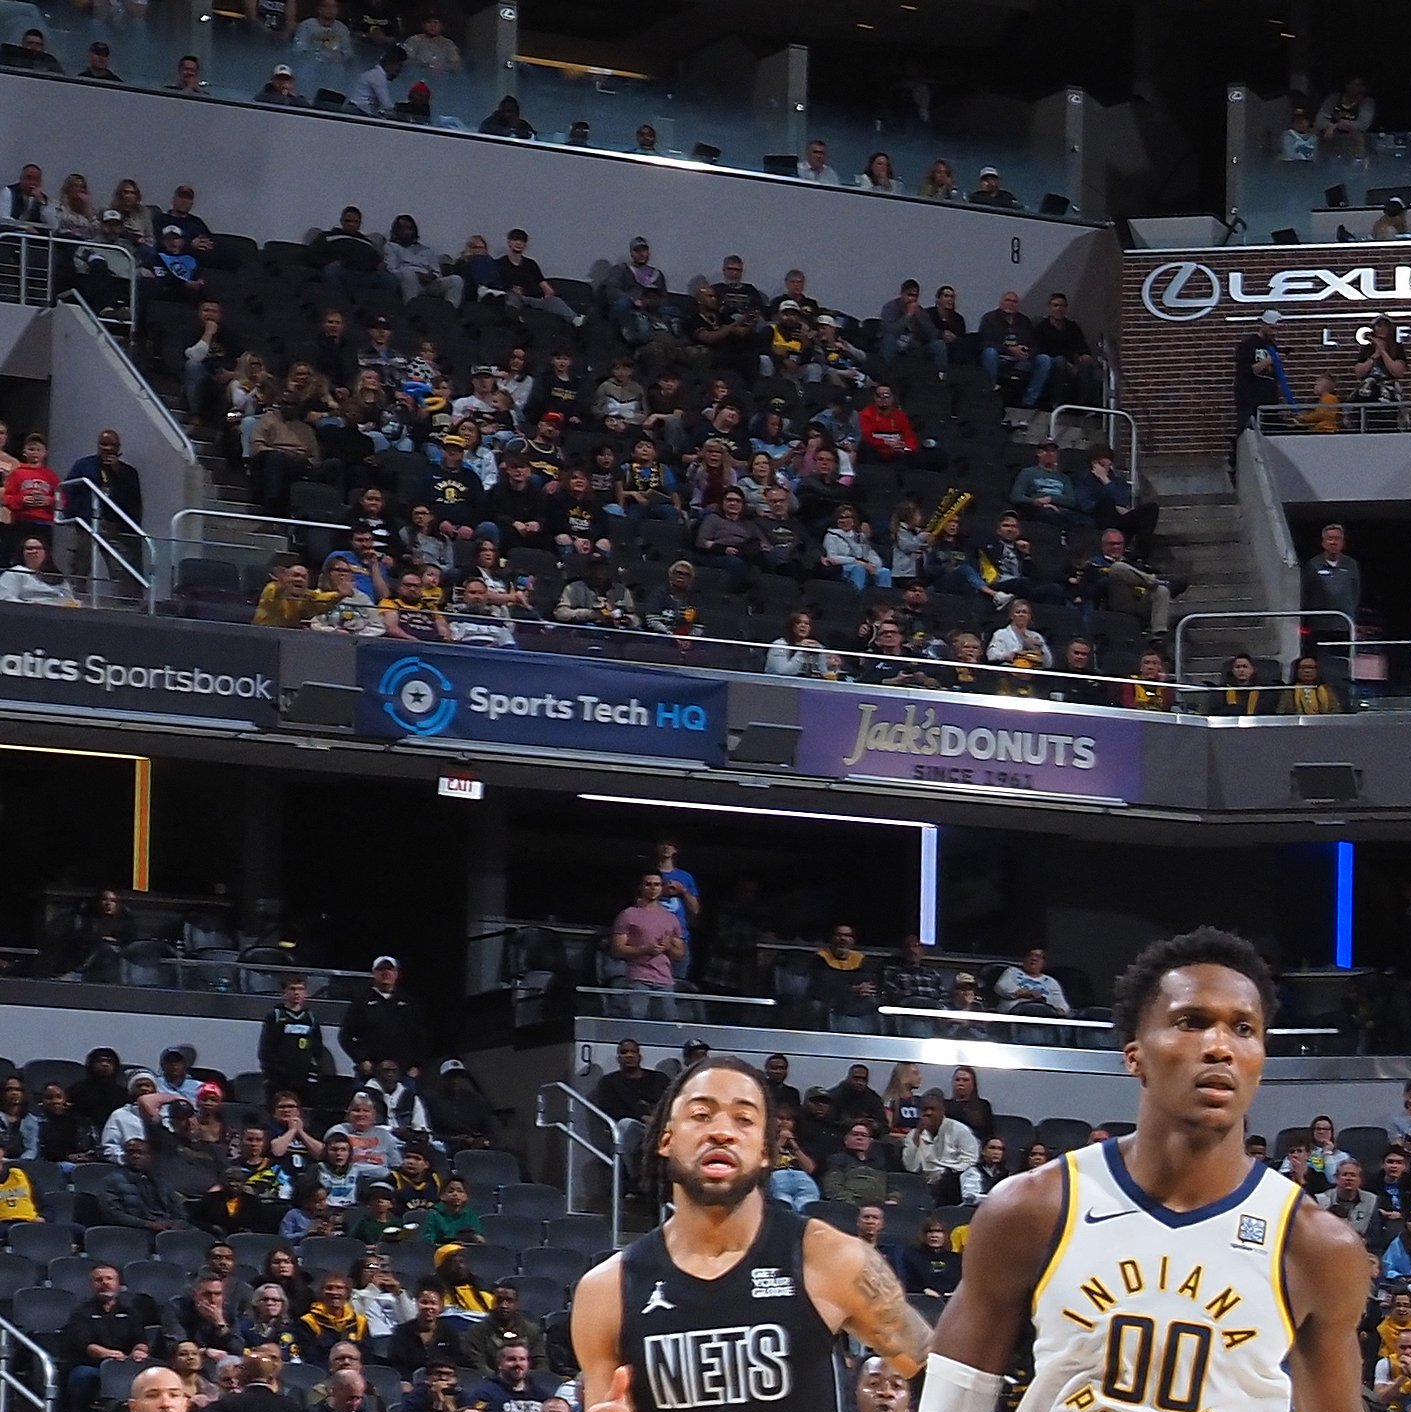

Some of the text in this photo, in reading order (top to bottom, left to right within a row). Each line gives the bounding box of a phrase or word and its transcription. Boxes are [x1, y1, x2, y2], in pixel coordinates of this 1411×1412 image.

[1011, 236, 1021, 265] 8
[83, 654, 274, 700] Sportsbook
[469, 686, 709, 732] Sports Tech HQ
[842, 703, 1097, 770] Jack's DONUTS
[913, 764, 974, 784] SINCE
[580, 1044, 593, 1077] 9
[751, 1267, 782, 1278] GET
[1062, 1256, 1258, 1351] INDIANA
[644, 1324, 791, 1409] NETS
